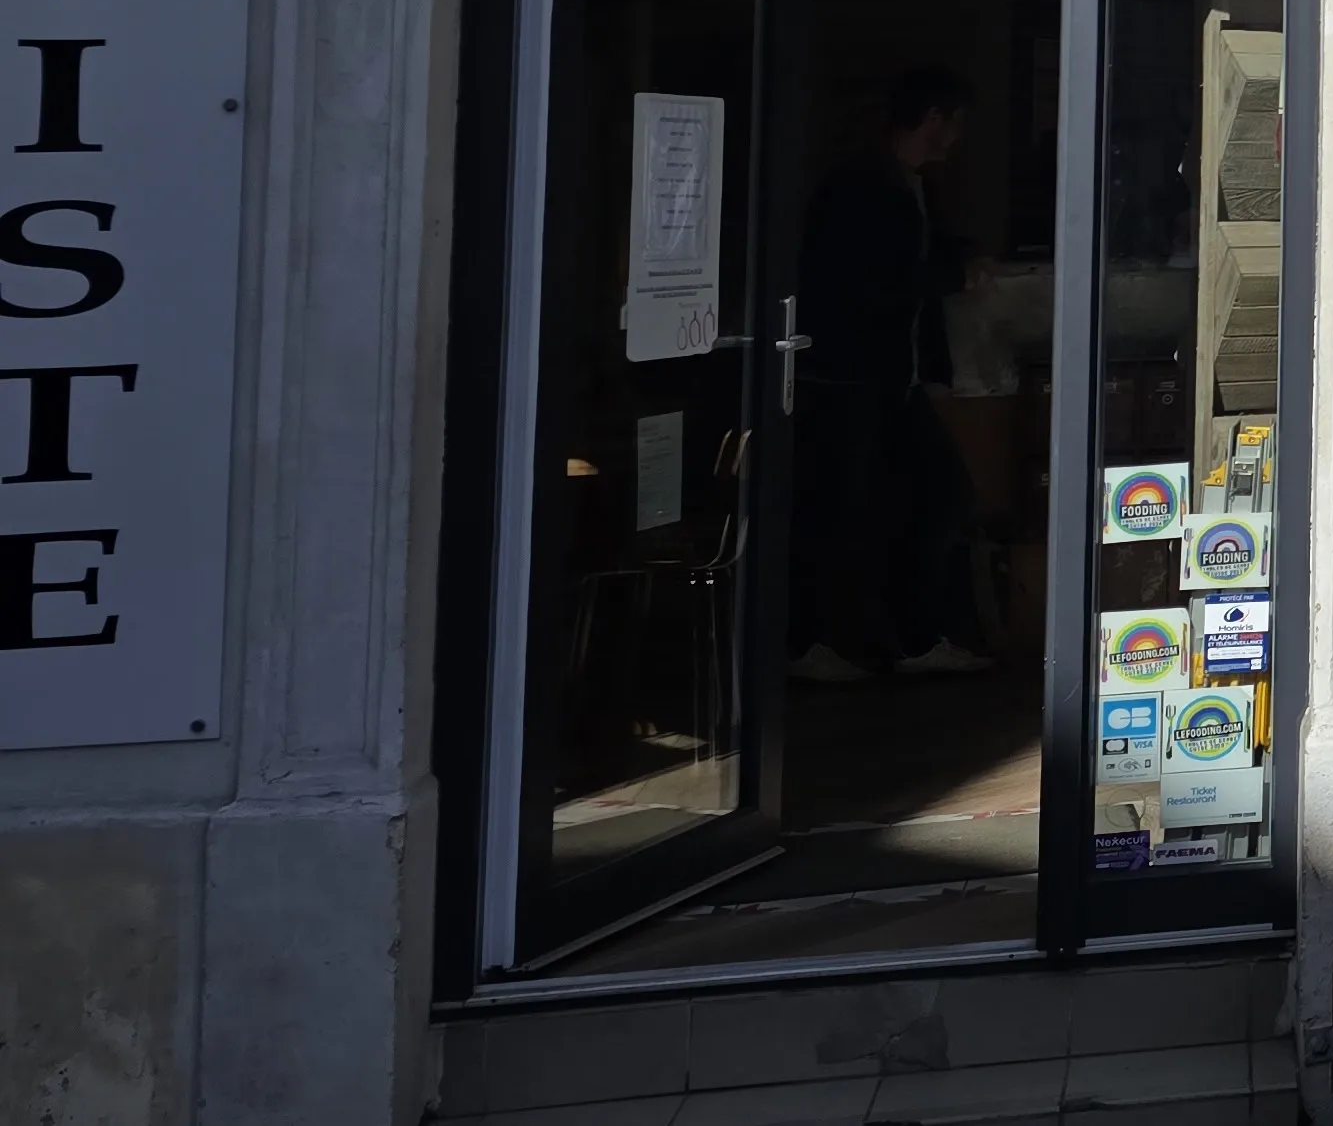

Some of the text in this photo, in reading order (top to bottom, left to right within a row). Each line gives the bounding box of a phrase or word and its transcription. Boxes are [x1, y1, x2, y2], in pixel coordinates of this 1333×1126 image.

[1121, 503, 1168, 517] FOODING
[1202, 551, 1249, 565] FOODING
[1218, 623, 1254, 632] Homiris
[1208, 633, 1238, 642] ALARME
[1111, 646, 1178, 663] LEFOODING.COM
[1175, 722, 1242, 740] LEFOODING.COM
[1133, 740, 1154, 749] VISA
[1190, 786, 1217, 796] Ticket
[1166, 794, 1217, 807] Restaurant
[1095, 836, 1145, 848] Nexecur
[1155, 846, 1216, 859] FAEMA
